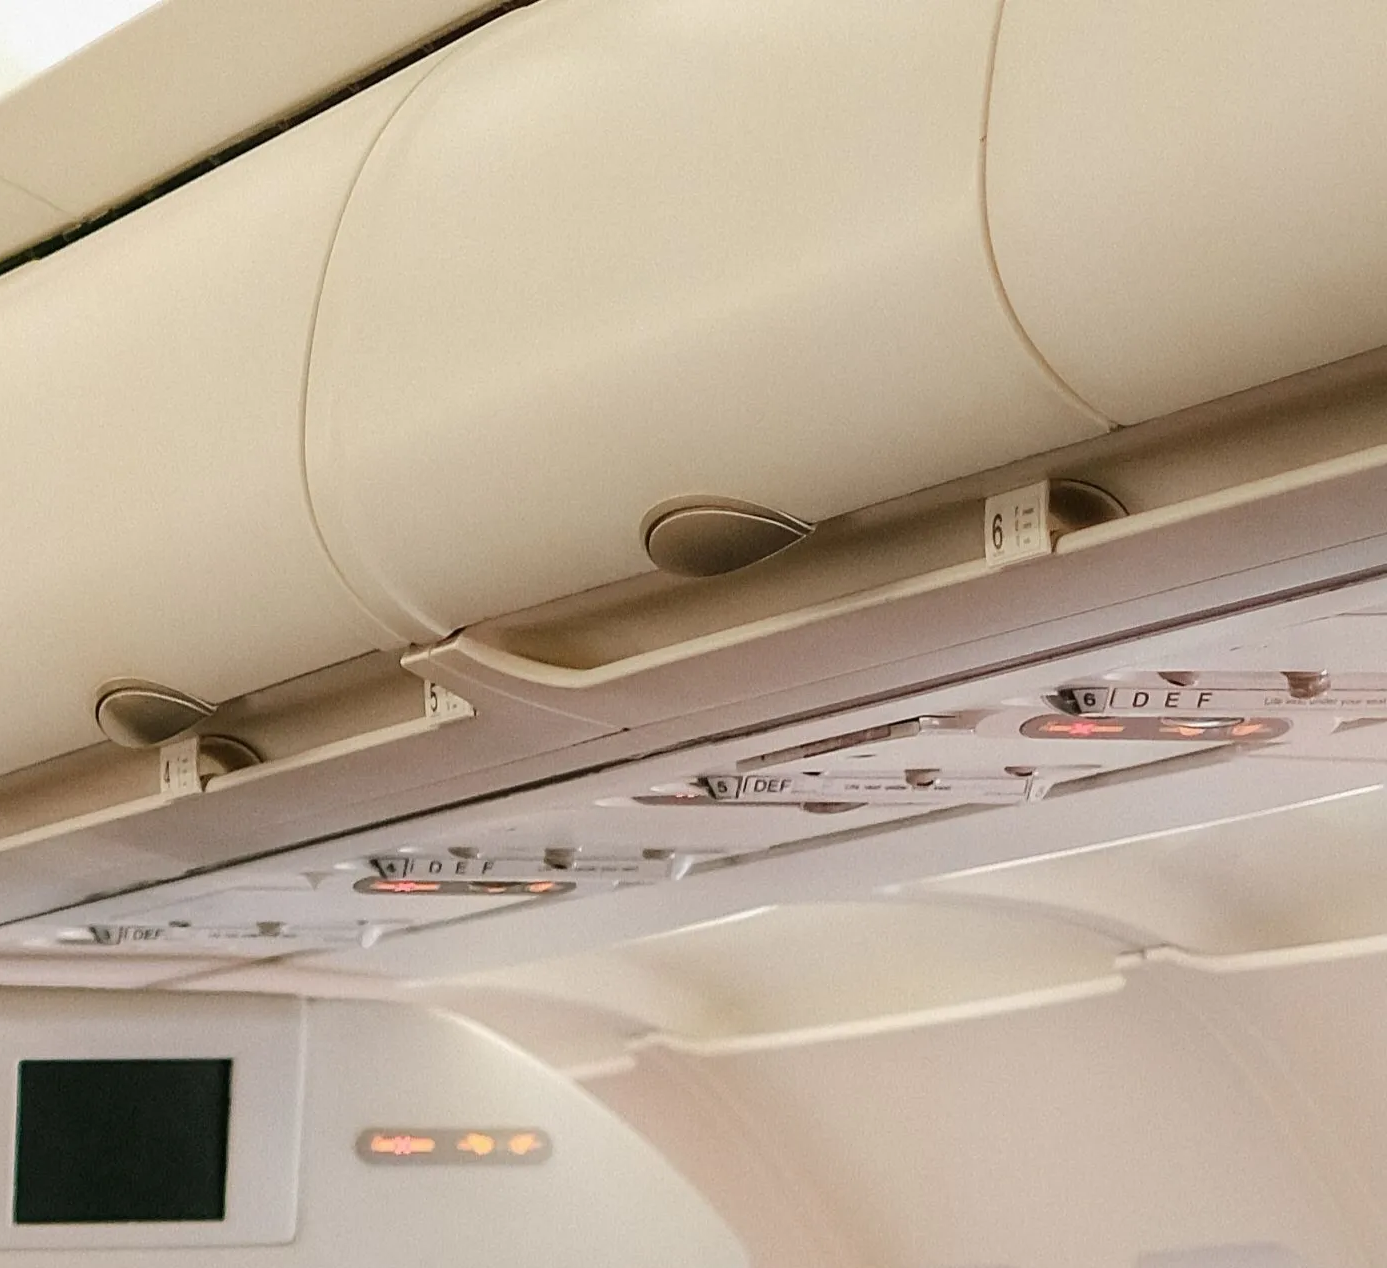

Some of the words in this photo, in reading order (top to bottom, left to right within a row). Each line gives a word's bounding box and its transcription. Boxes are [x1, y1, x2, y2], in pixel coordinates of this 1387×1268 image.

[992, 513, 1003, 550] 6
[1083, 693, 1096, 707] 6
[753, 779, 792, 793] DEF
